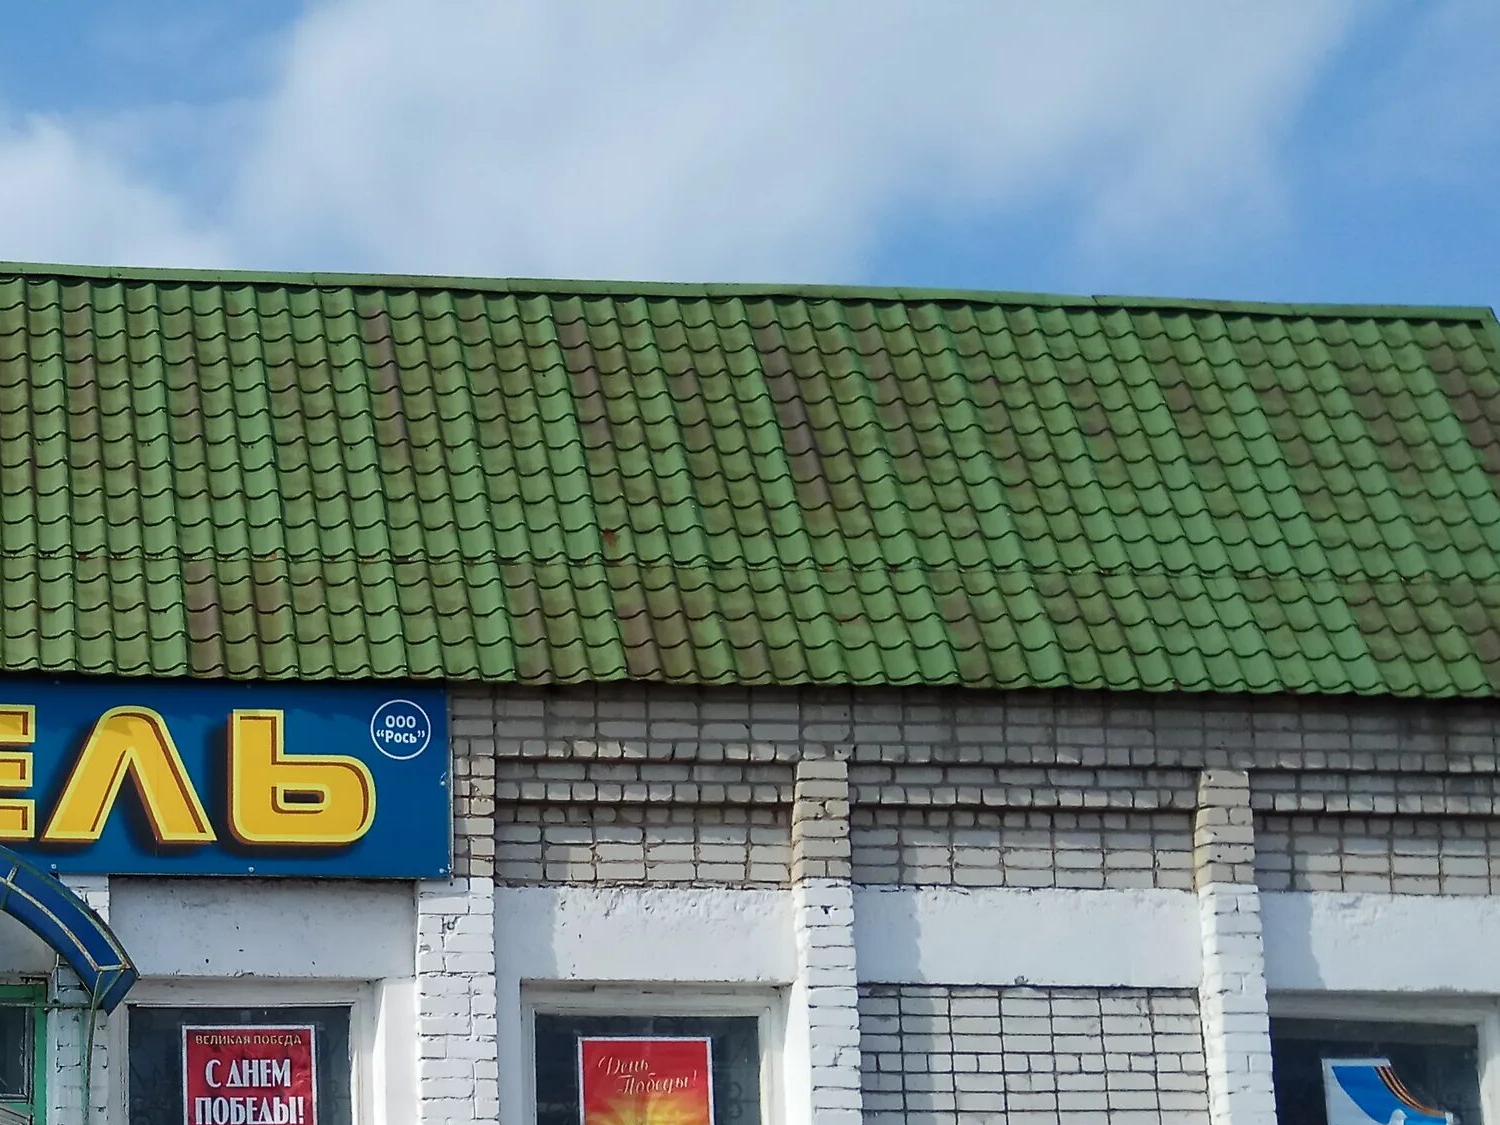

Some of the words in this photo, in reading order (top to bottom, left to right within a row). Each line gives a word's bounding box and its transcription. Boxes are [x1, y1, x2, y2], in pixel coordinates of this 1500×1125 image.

[385, 715, 416, 728] ООО
[195, 1034, 250, 1045] ВЕЛИКАЯ
[254, 1034, 302, 1046] ПОБЕДА
[205, 1059, 221, 1088] С
[226, 1059, 291, 1088] ДНЕМ
[195, 1096, 304, 1125] ПОБЕДЫ!
